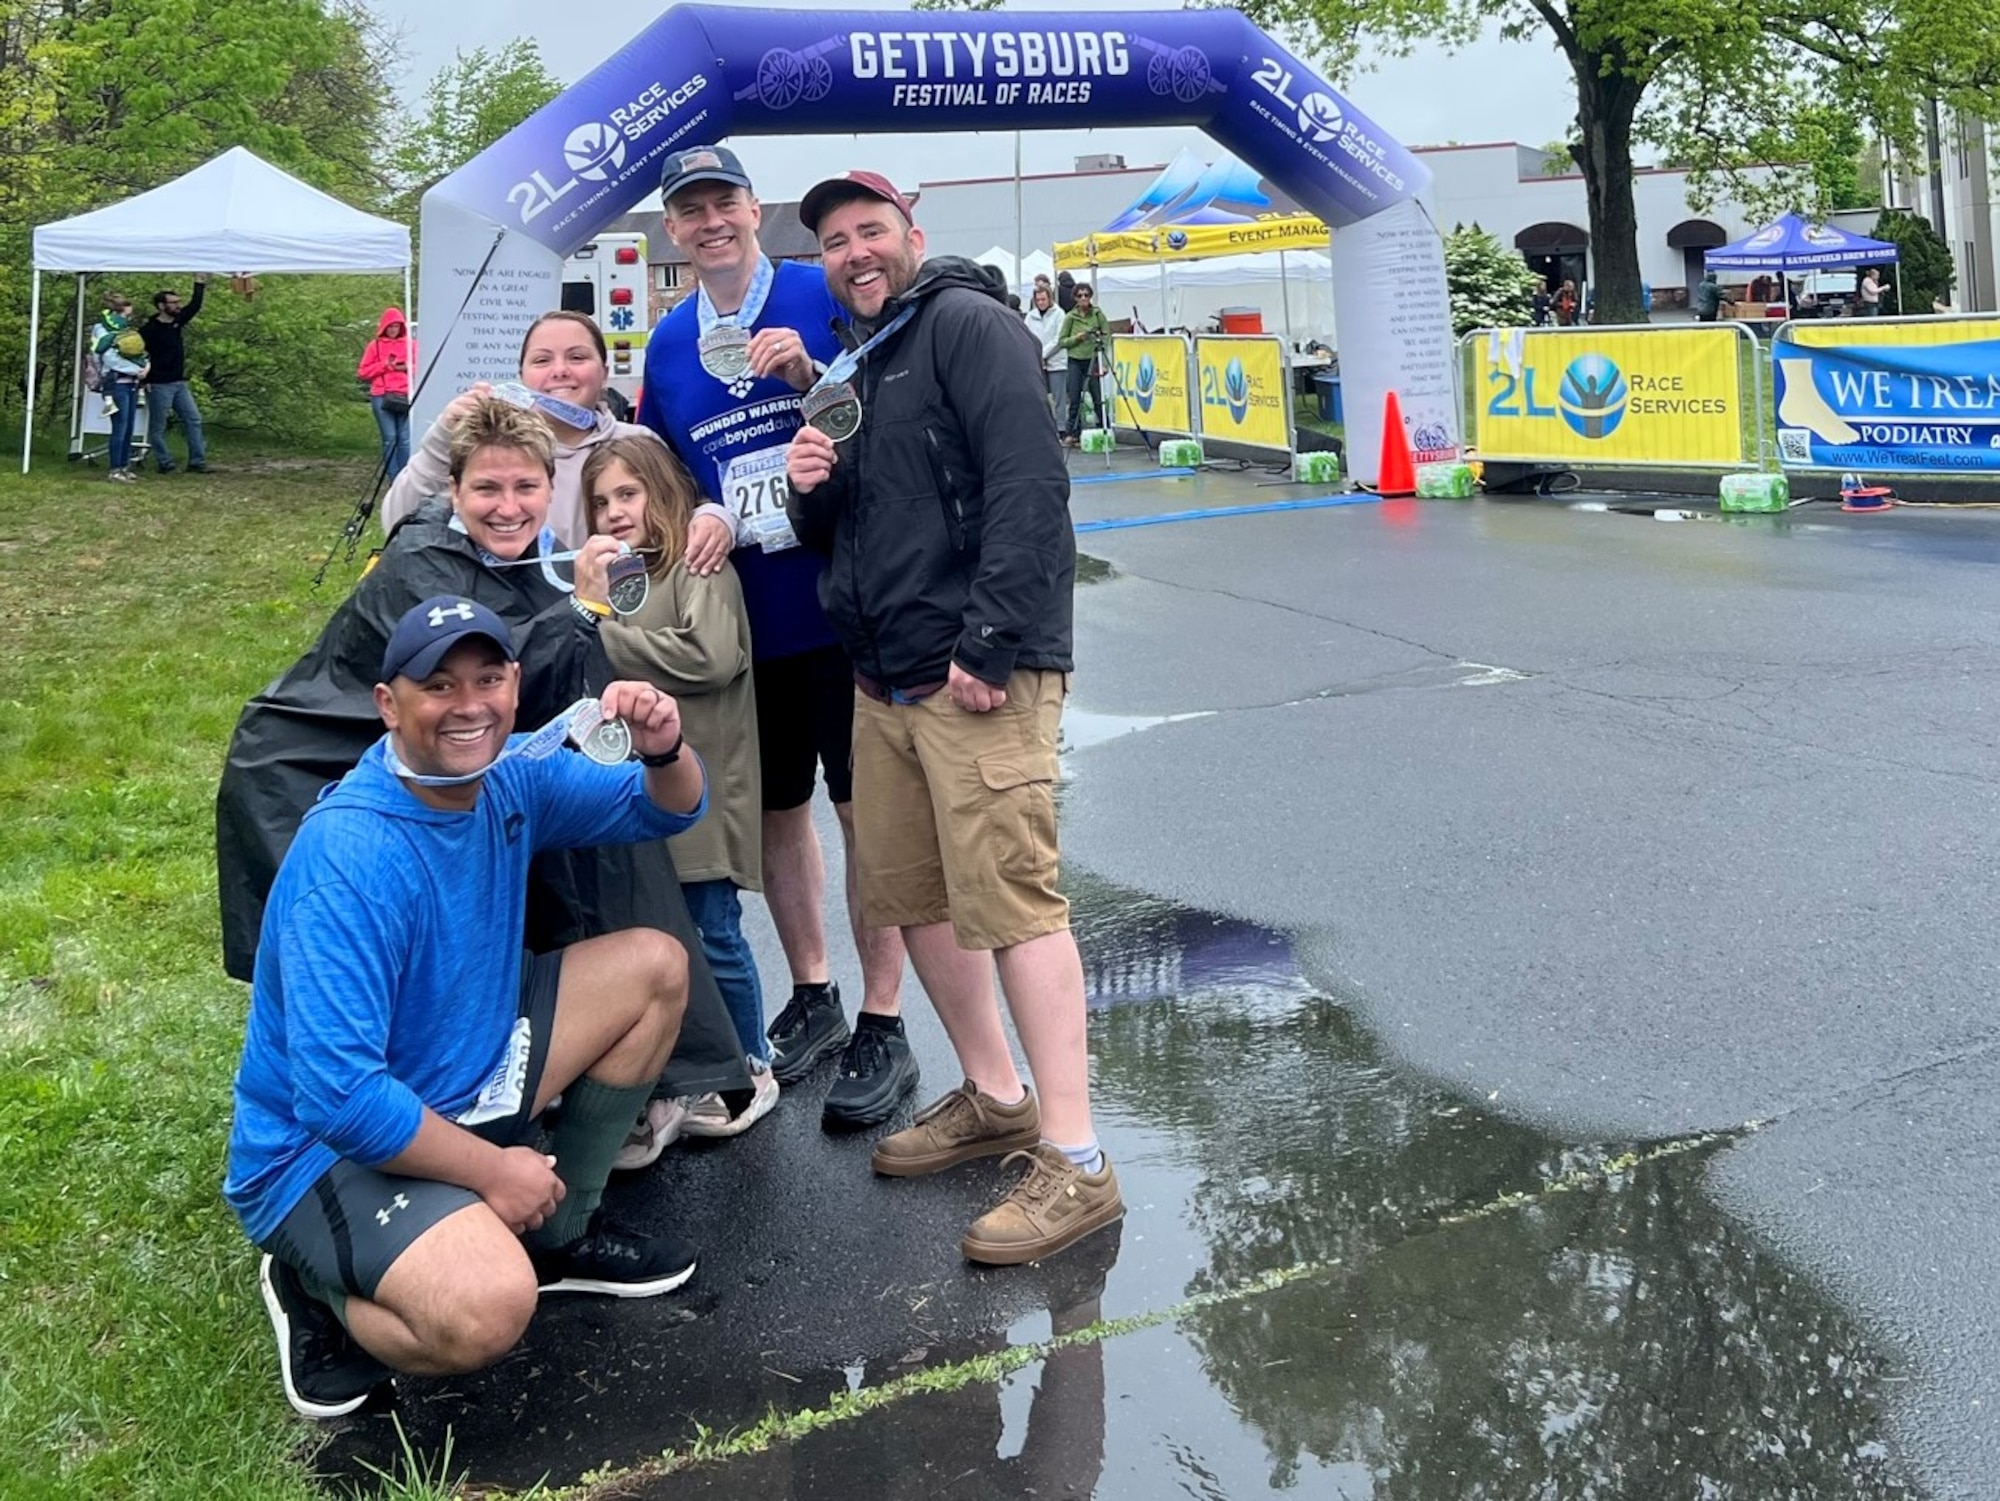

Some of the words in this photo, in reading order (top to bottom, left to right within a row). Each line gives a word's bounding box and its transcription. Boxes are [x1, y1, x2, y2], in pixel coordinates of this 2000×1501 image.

[850, 31, 1129, 79] GETTYSBURG
[893, 83, 988, 107] FESTIVAL
[996, 82, 1022, 105] OF
[1027, 81, 1092, 105] RACES
[1250, 57, 1299, 112] 2L
[609, 82, 667, 128] RACE
[623, 73, 708, 142] SERVICES
[1249, 100, 1271, 119] RACE
[1270, 116, 1297, 140] TIMING
[1302, 141, 1328, 164] EVENT
[1327, 161, 1378, 200] MANAGEMENT
[1344, 121, 1386, 161] RACE
[552, 211, 578, 233] RACE
[578, 186, 610, 214] TIMING
[619, 157, 649, 182] EVENT
[649, 109, 709, 159] MANAGEMENT
[1337, 133, 1405, 192] SERVICES
[506, 168, 580, 226] 2L
[1229, 229, 1272, 243] EVENT
[1279, 225, 1329, 237] MANAG
[1786, 252, 1842, 265] BATTLEFIELD
[1843, 251, 1866, 261] BREW
[1867, 249, 1897, 260] WORKS
[497, 269, 515, 277] ARE
[501, 284, 528, 292] GREAT
[480, 298, 502, 306] CIVIL
[462, 312, 500, 320] TESTING
[502, 313, 539, 321] WHETHE
[473, 327, 495, 335] THAT
[500, 327, 527, 335] NATIO
[483, 342, 500, 350] ANY
[456, 371, 476, 379] AND
[494, 372, 518, 380] DEDIC
[1202, 364, 1228, 406] 2L
[1630, 375, 1684, 391] RACE
[456, 386, 470, 394] CA
[1487, 367, 1557, 417] 2L
[1829, 371, 1893, 408] WE
[1900, 373, 2000, 409] TREA
[1629, 398, 1727, 414] SERVICES
[690, 411, 746, 442] WOUNDED
[749, 398, 806, 419] WARRIO
[1860, 425, 1973, 444] PODIATRY
[1832, 450, 1983, 466] www.WeTreatFeet.com
